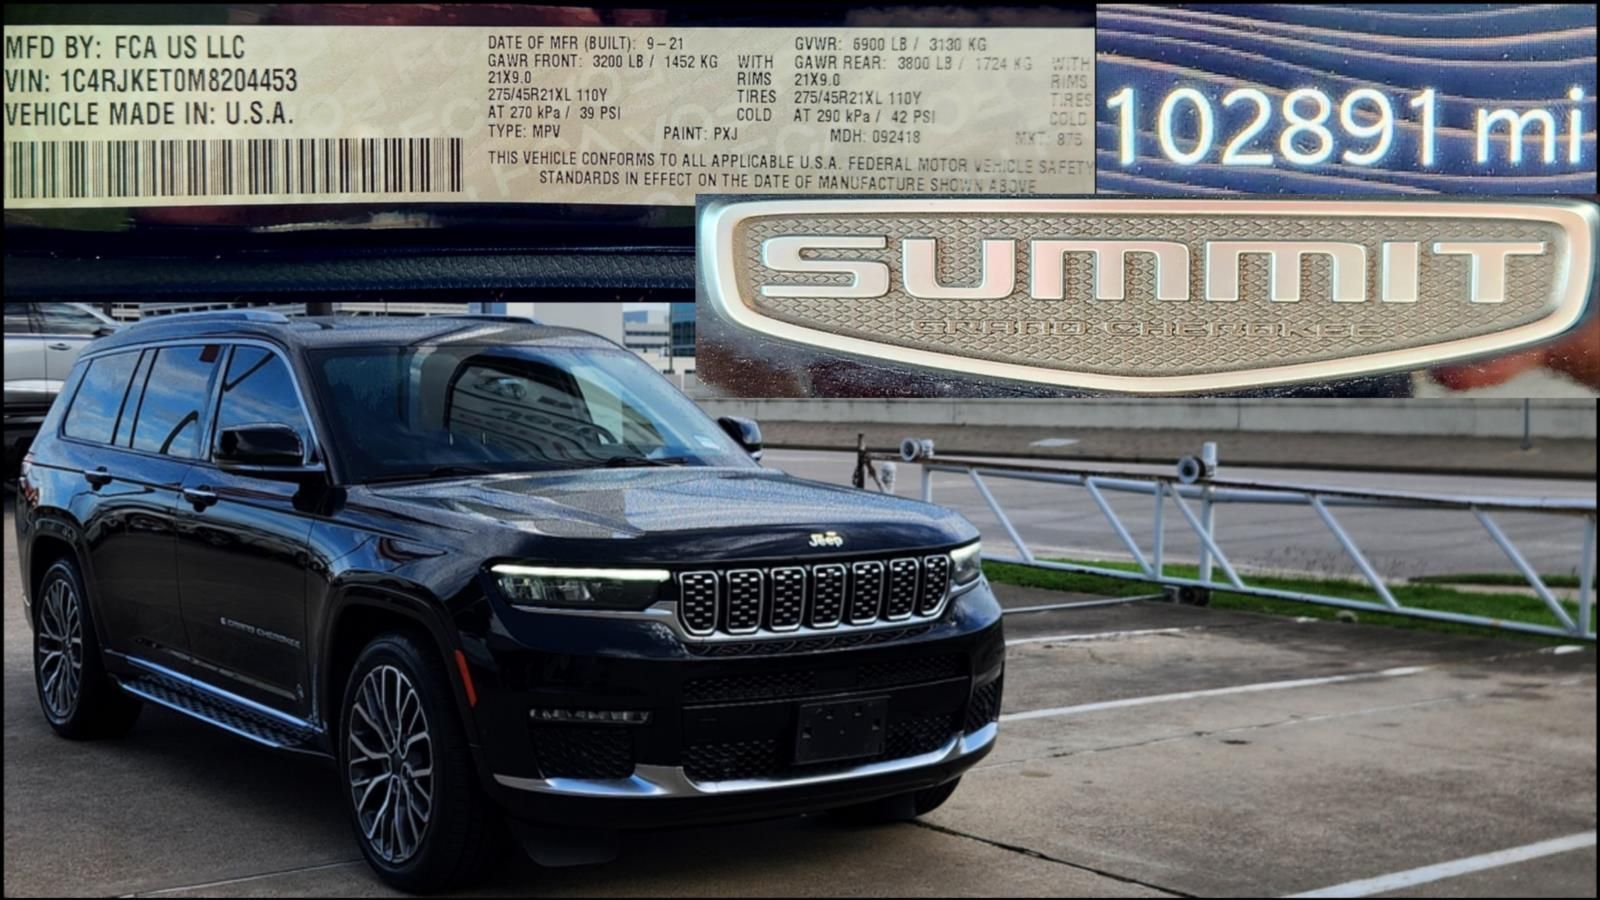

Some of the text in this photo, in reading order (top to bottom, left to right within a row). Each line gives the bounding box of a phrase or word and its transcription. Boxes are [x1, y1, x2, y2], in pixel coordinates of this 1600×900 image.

[6, 35, 245, 58] MFD BY: FCA US LLC
[488, 36, 522, 50] DATE
[528, 36, 544, 50] OF
[550, 36, 578, 50] MFR
[585, 36, 635, 51] (BUILT):
[795, 37, 987, 51] GVWR: 6900 LB / 3130 KG
[488, 54, 718, 68] GAWR FRONT: 3200 LB / 1452 KG
[738, 55, 773, 69] WITH
[795, 55, 837, 69] GAWR
[843, 56, 886, 70] REAR:
[897, 56, 930, 70] 3800
[936, 56, 952, 70] LB
[976, 57, 1007, 70] 1724
[1014, 57, 1032, 70] KG
[1052, 57, 1090, 71] WITH
[6, 68, 297, 92] VIN: 1C4RJKET0M8204453
[488, 71, 531, 84] 21X9.0
[737, 72, 771, 86] RIMS
[794, 73, 840, 86] 21X9.0
[1051, 74, 1087, 88] RIMS
[488, 88, 607, 101] 275/45R21XL 110Y
[737, 90, 776, 103] TIRES
[794, 91, 922, 104] 275/45R21XL 110Y
[1051, 92, 1092, 107] TIRES
[6, 102, 99, 126] VEHICLE
[110, 102, 175, 125] MADE
[185, 102, 215, 125] IN:
[226, 101, 293, 124] U.S.A.
[488, 106, 621, 120] AT 270 kPa / 39 PSI
[737, 108, 772, 121] COLD
[793, 109, 935, 123] AT 290 kPa / 42 PSI
[1050, 112, 1087, 126] COLD
[488, 125, 560, 138] TYPE: MPV
[1106, 85, 1585, 167] 102891 mi
[664, 127, 738, 140] PAINT: PXJ
[830, 129, 920, 143] MDH: 092418
[488, 151, 1094, 175] THIS VEHICLE CONFORMS TO ALL APPLICABLE U.S.A. FEDERAL MOTOR VEHICLE SAFETY
[540, 171, 1036, 193] STANDARDS IN EFFECT ON THE DATE OF MANUFACTURE SHOWN ABOVE
[762, 234, 1547, 304] SUMMIT
[808, 531, 844, 548] Jeep
